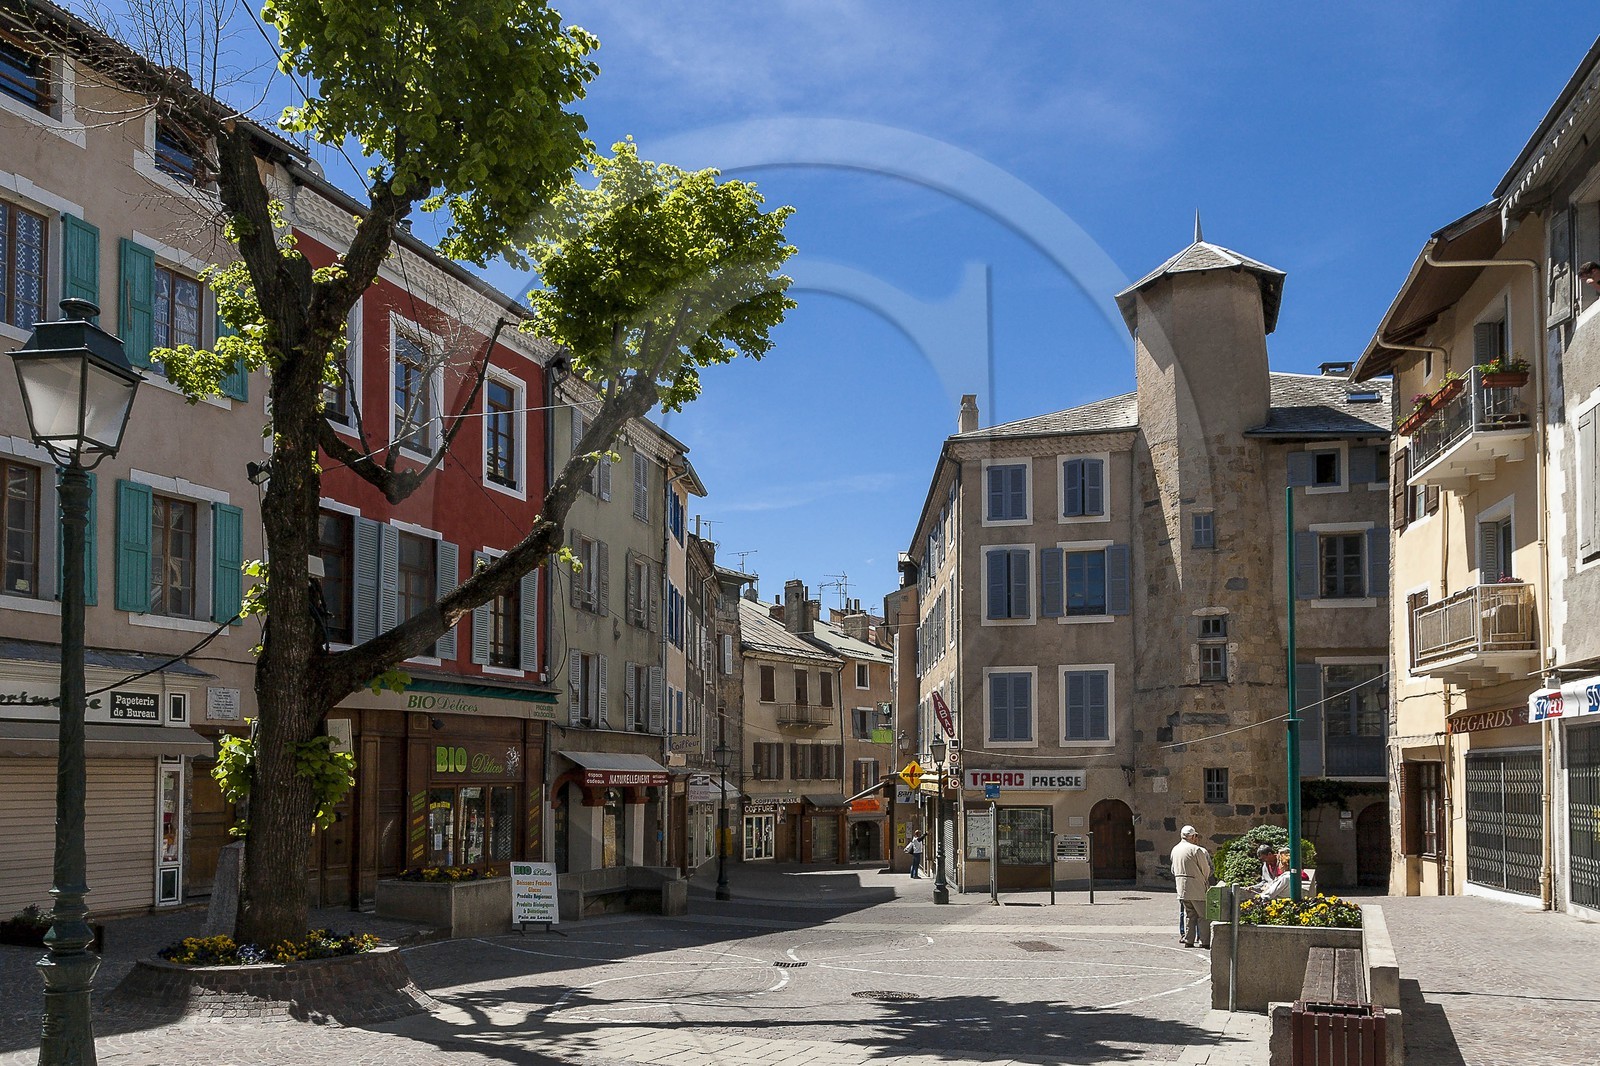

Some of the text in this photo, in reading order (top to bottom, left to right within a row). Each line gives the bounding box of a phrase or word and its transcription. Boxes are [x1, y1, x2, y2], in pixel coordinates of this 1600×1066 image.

[115, 695, 155, 708] Papeterie
[408, 695, 436, 709] BIO
[113, 708, 156, 719] de Bureau
[932, 693, 954, 736] TABAC
[1452, 709, 1513, 733] REGARDS
[672, 739, 700, 751] Coiffeur
[436, 746, 468, 773] BIO
[609, 774, 650, 784] NATURELLEMENT
[970, 773, 1082, 787] TABAC PRESSE
[898, 790, 913, 798] gan
[744, 805, 775, 813] COIFFURE
[514, 866, 532, 875] BIO
